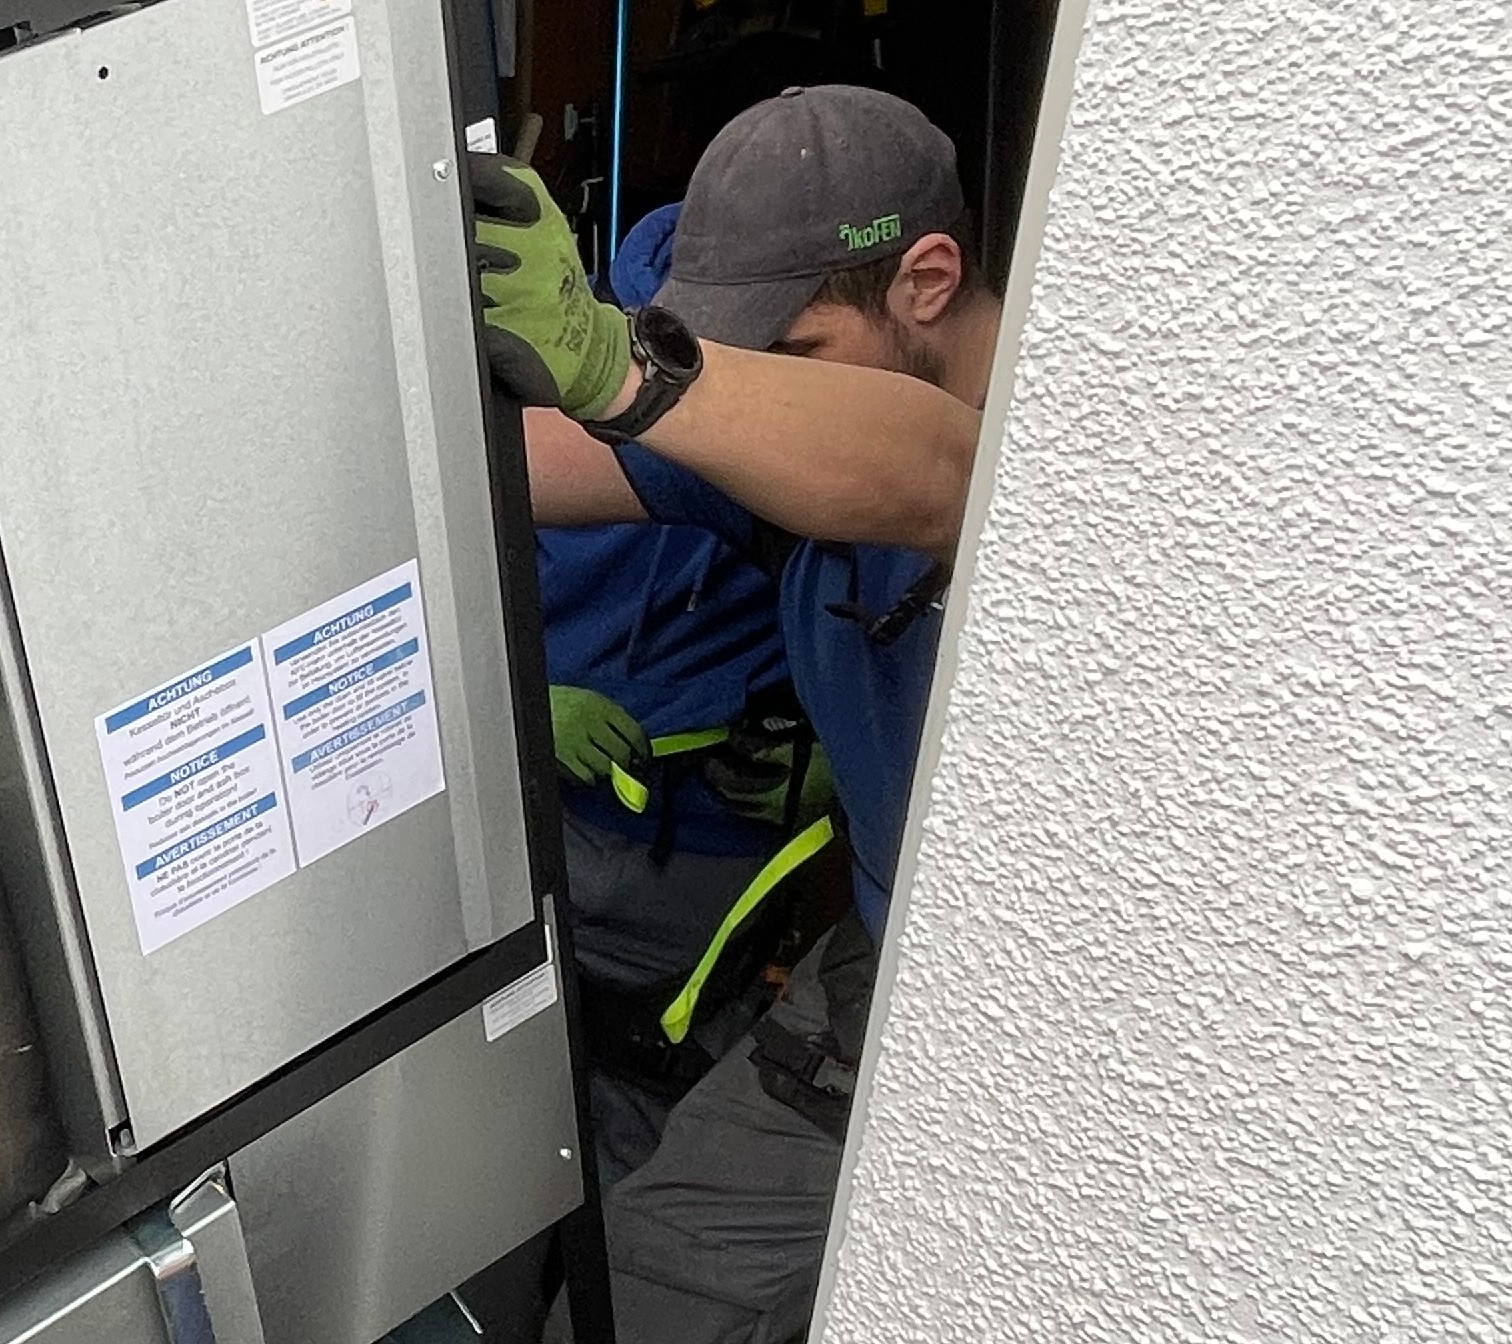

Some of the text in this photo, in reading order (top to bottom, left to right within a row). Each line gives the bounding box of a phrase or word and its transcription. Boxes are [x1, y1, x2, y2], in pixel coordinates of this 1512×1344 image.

[311, 603, 374, 645] ACHTUNG
[146, 668, 213, 712] ACHTUNG
[328, 662, 374, 695] NOTICE
[169, 706, 202, 731] NICHT
[308, 701, 408, 762] AVERTISSEMENT
[169, 749, 219, 785] NOTICE
[173, 780, 195, 799] NOT
[153, 802, 259, 869] AVERTISSEMENT
